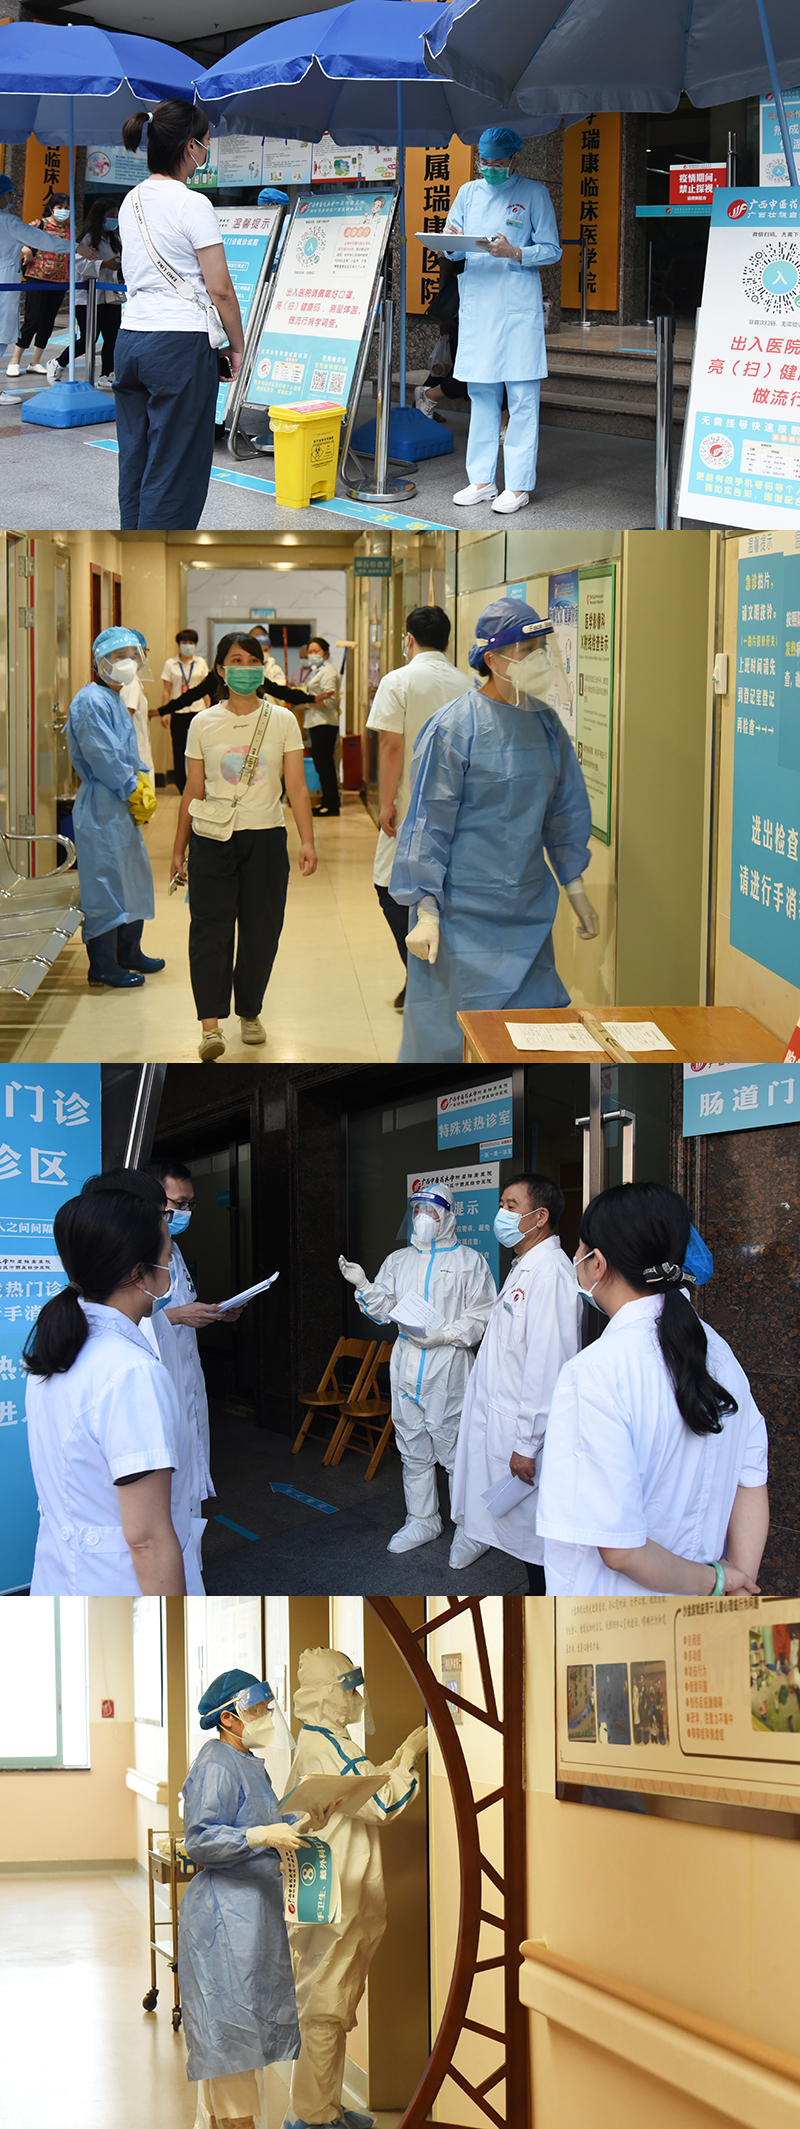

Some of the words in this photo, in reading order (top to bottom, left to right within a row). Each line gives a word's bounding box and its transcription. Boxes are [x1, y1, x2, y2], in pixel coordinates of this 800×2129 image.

[769, 110, 800, 121] 共疫情
[679, 172, 718, 183] 疫情期间，
[749, 198, 800, 211] 广西中医药
[232, 217, 271, 230] 温馨提示
[747, 211, 800, 219] 广西壮族自
[421, 147, 450, 304] 属瑞康医院
[772, 270, 788, 286] 入
[285, 288, 356, 301] 出入医院请佩戴好口罩，
[275, 302, 361, 315] 亮（扫）健康码，测量体温，
[288, 316, 339, 329] 做流行病学调查。
[748, 319, 800, 328] 非首次扫码，无需验
[731, 335, 800, 355] 出入医院
[708, 358, 800, 381] 亮（扫）健
[753, 387, 800, 407] 做流行
[702, 415, 800, 436] 无需挂号快速核酸
[745, 572, 774, 591] 急诊拍片，
[741, 604, 777, 622] 请文明按铃。
[738, 657, 776, 676] 上班时间请先
[737, 686, 775, 708] 到登记室登记
[751, 814, 799, 862] 进出检查
[739, 864, 800, 921] 请进行手消
[5, 1081, 90, 1126] 门诊
[699, 1078, 795, 1117] 肠道门
[439, 1110, 510, 1138] 特殊发热诊室
[0, 1143, 69, 1186] 诊区
[454, 1200, 479, 1216] 提示
[0, 1304, 41, 1322] 手消
[0, 1355, 28, 1380] 热
[0, 1400, 27, 1427] 进
